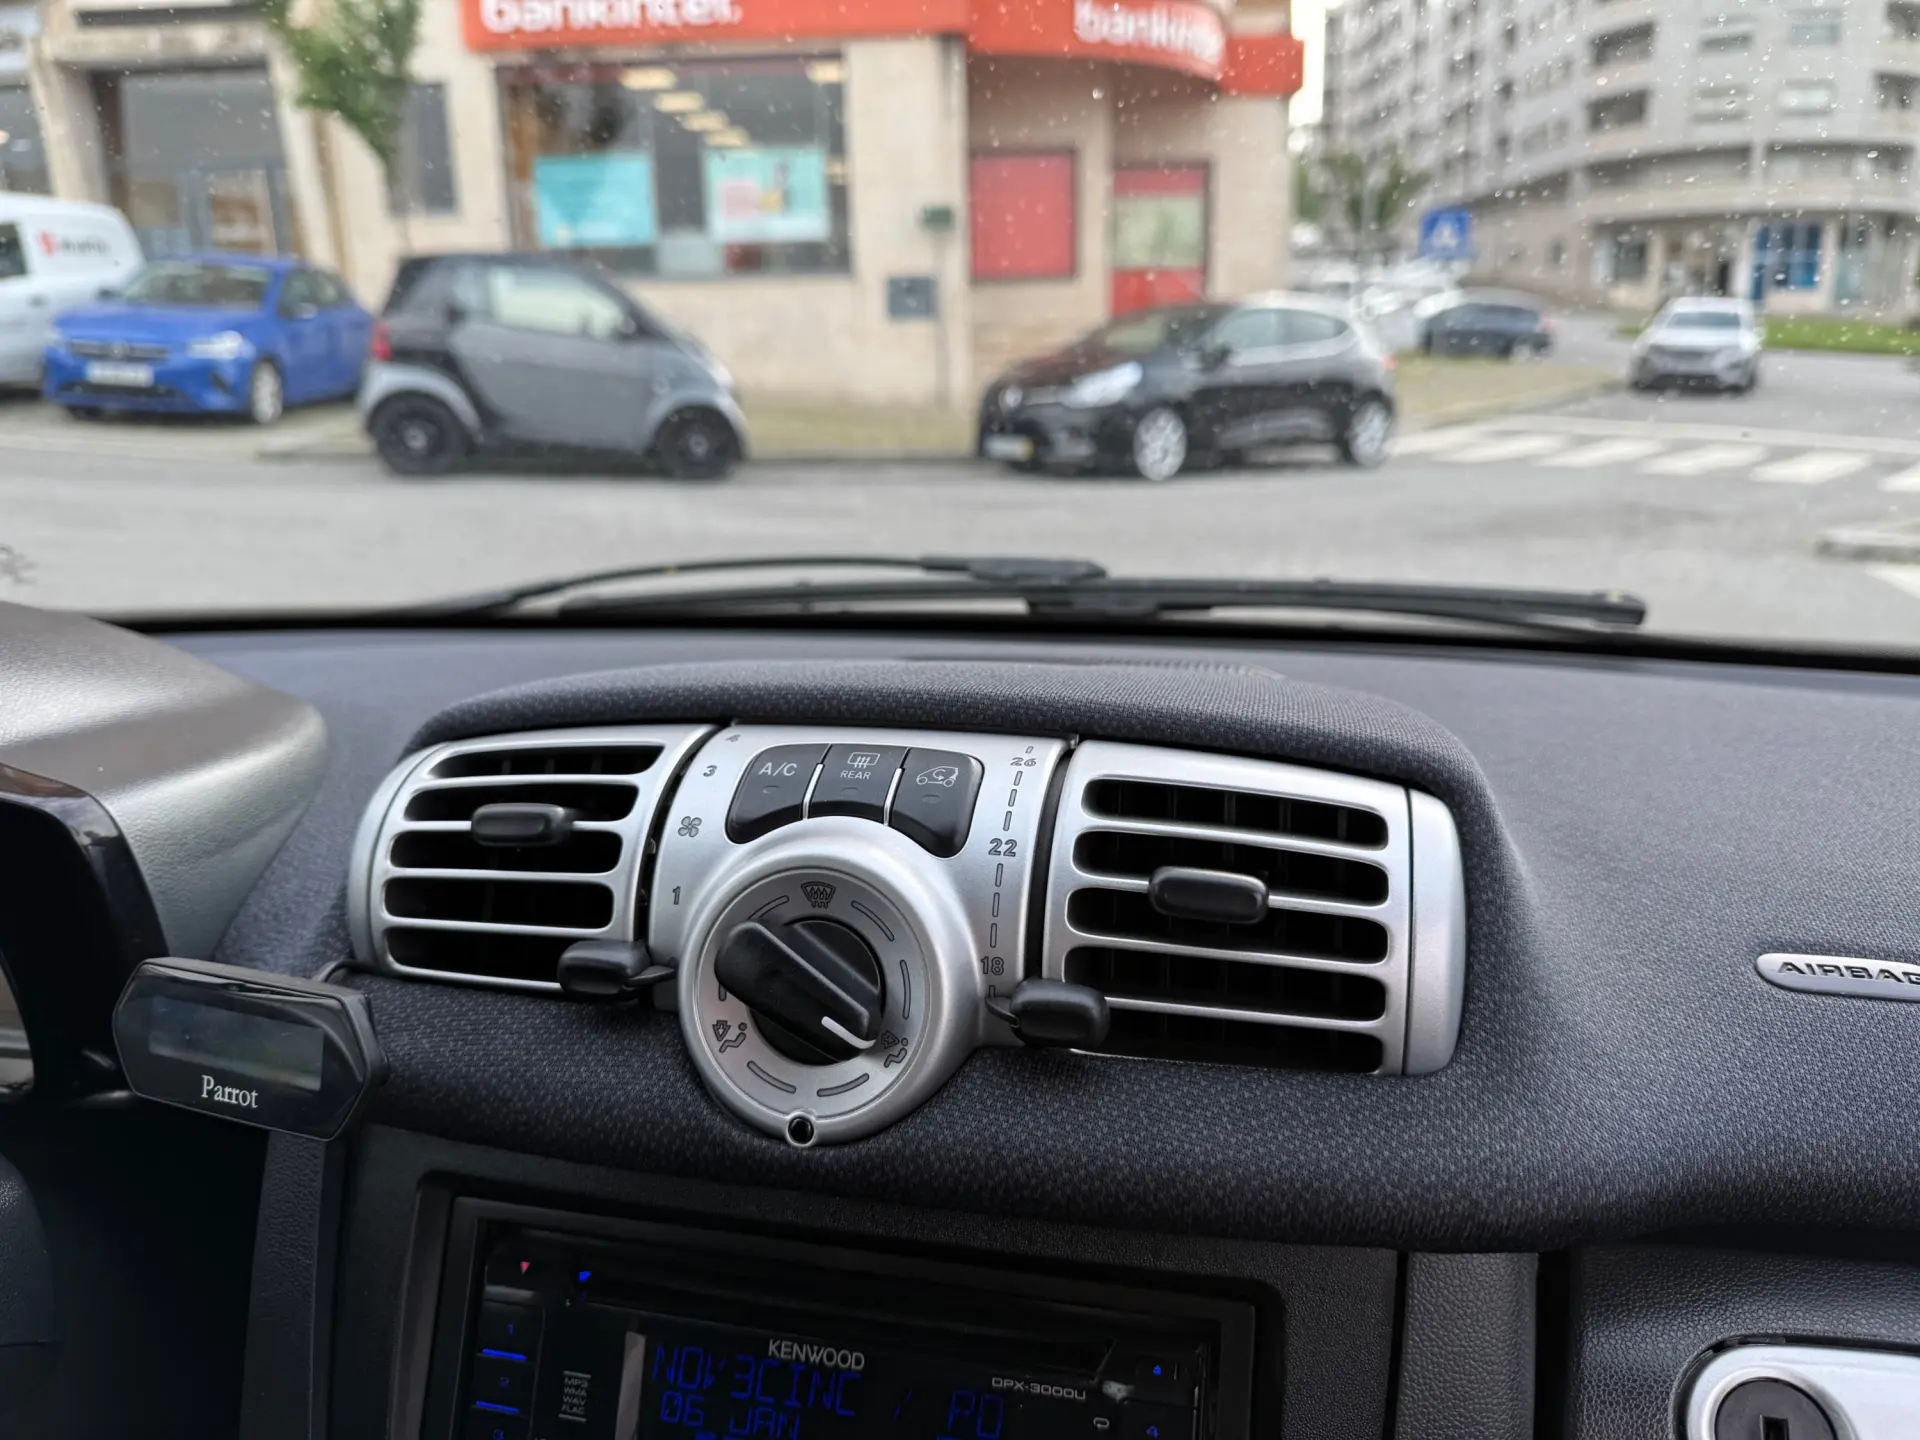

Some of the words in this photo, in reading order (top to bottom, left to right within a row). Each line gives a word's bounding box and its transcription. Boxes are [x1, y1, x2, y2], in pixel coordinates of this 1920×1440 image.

[758, 761, 798, 777] A/C
[1010, 757, 1037, 767] 26
[703, 764, 718, 777] 3
[839, 769, 872, 781] REAR
[988, 837, 1018, 857] 22
[672, 886, 682, 905] 1
[980, 956, 1005, 976] 18
[200, 1075, 259, 1109] Parrot
[768, 1338, 866, 1371] KENWOOD
[564, 1376, 589, 1388] MP3
[991, 1376, 1087, 1401] DPX-3000U
[564, 1385, 587, 1397] WMA
[562, 1394, 587, 1407] WAV
